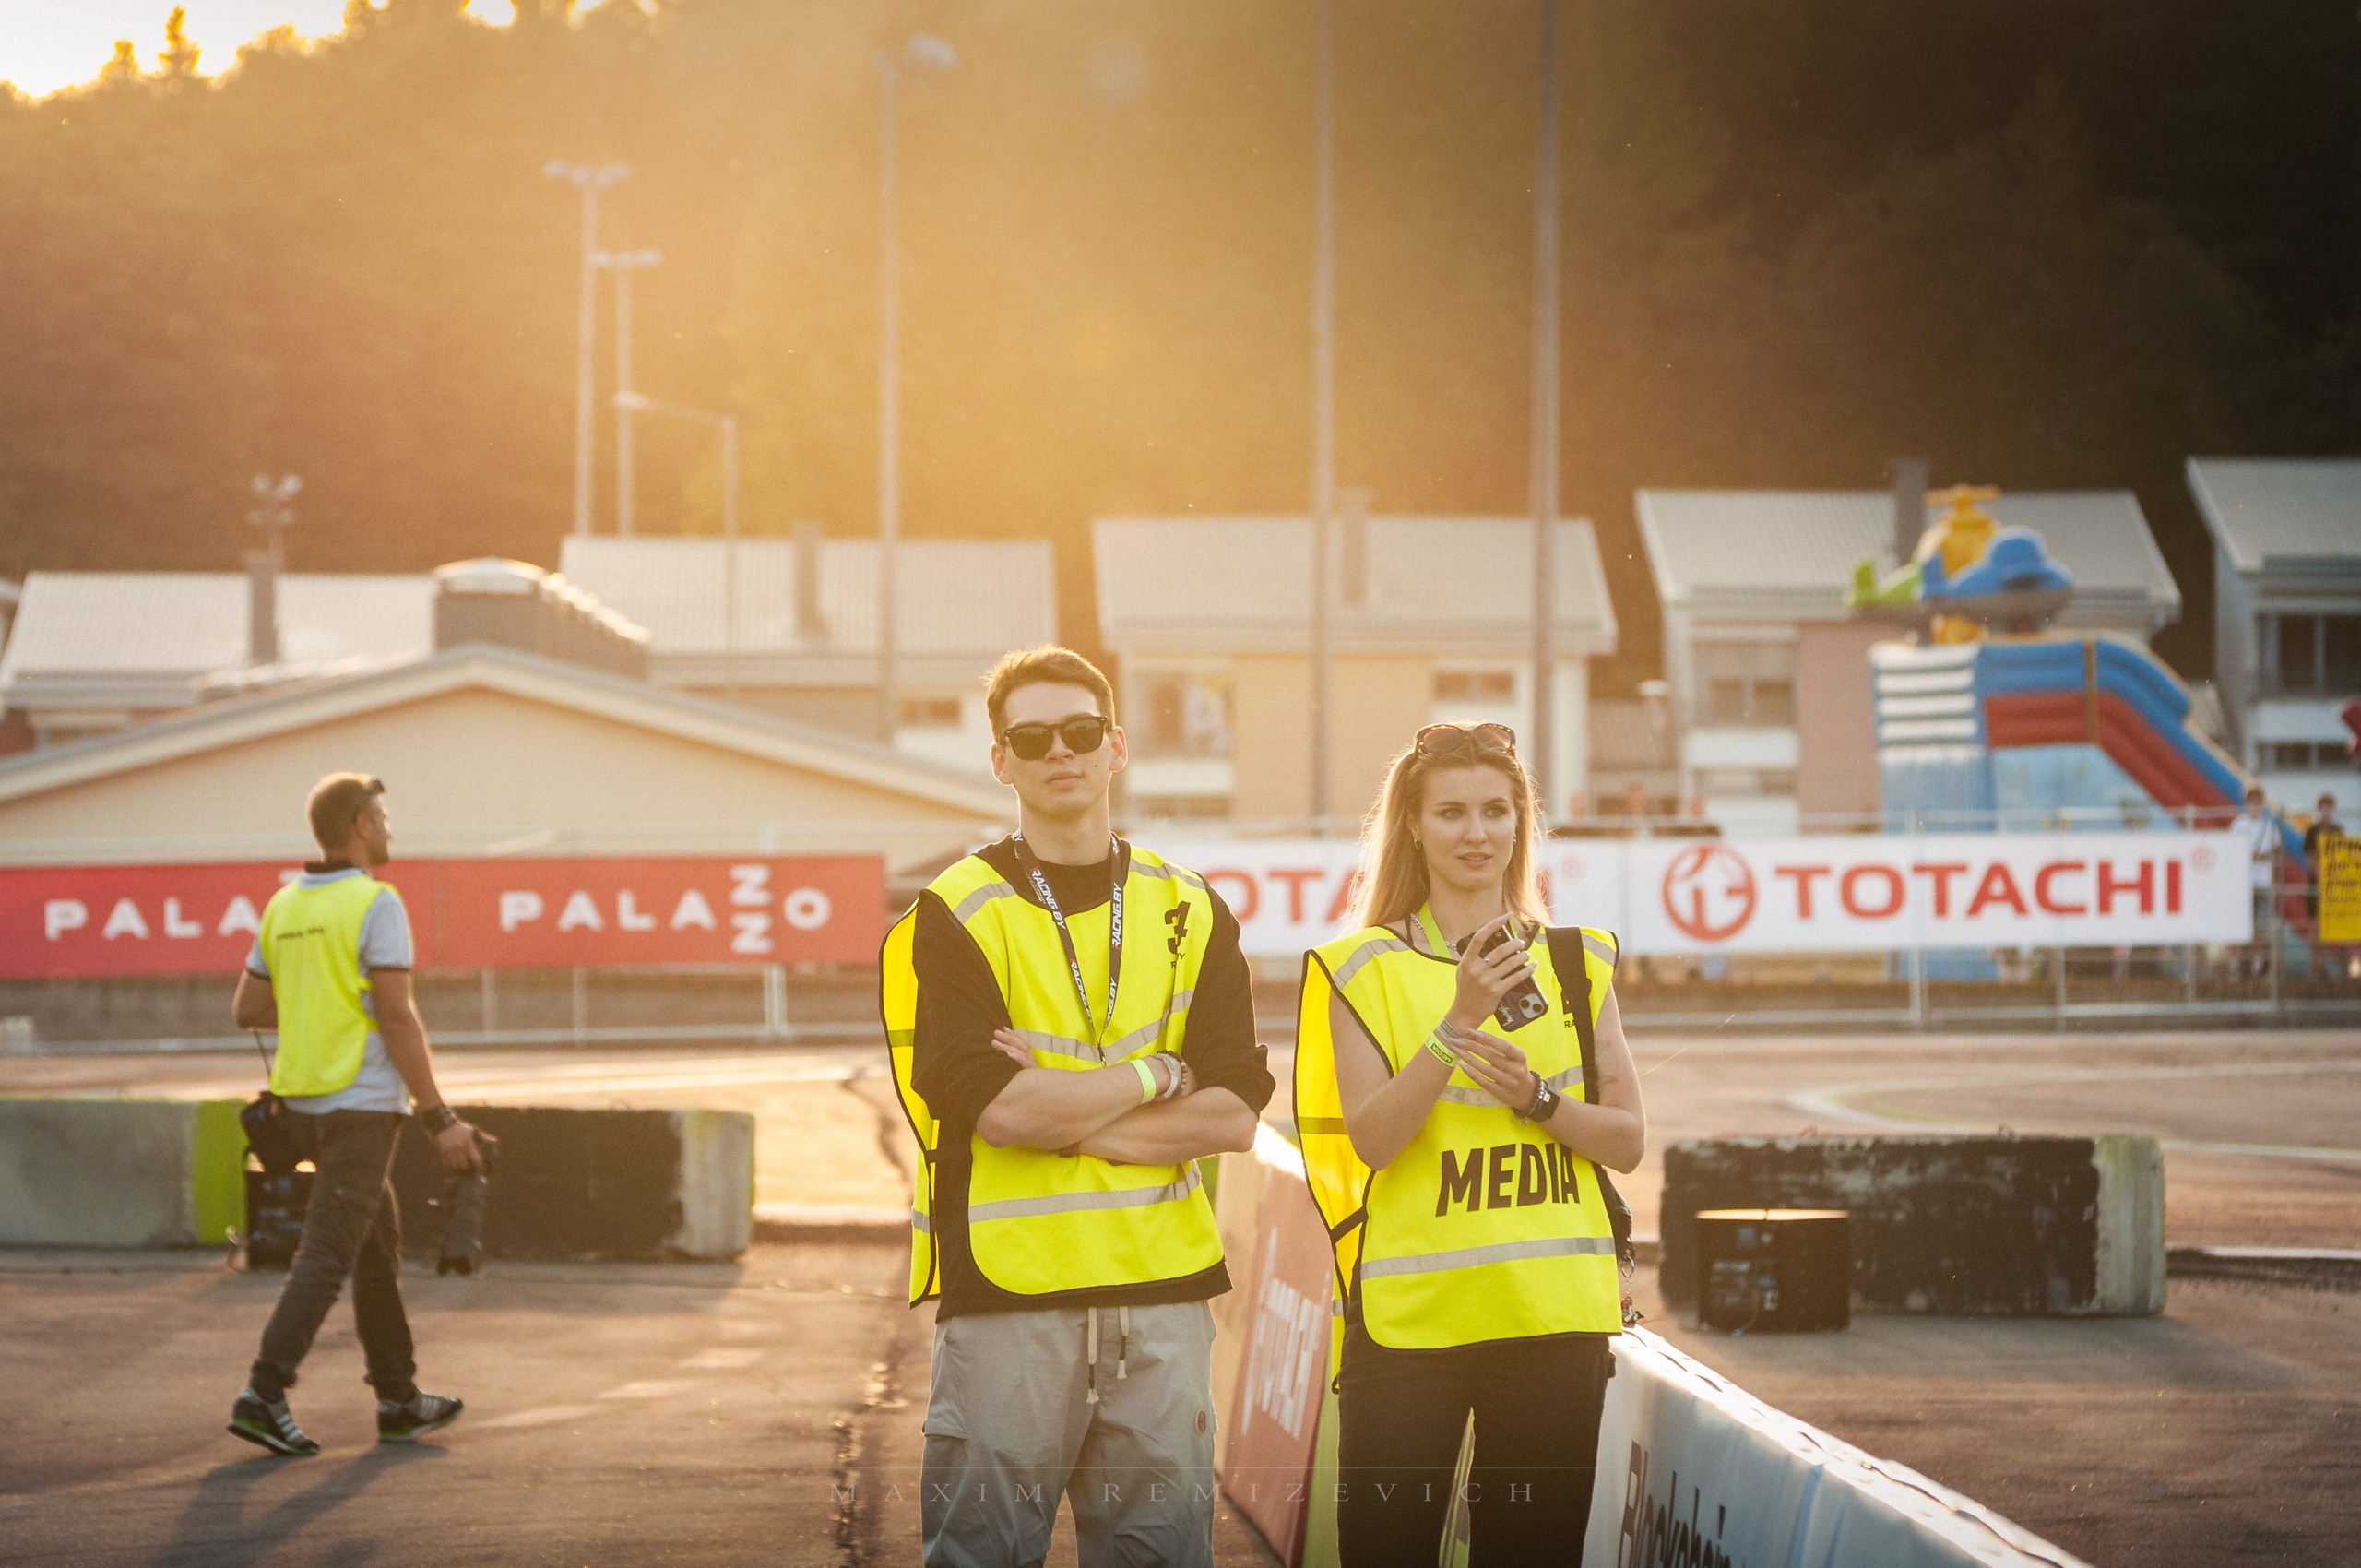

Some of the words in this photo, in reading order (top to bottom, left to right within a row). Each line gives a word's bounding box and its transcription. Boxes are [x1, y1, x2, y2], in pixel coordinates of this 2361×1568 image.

[43, 872, 303, 940] PALA
[499, 864, 832, 954] PALAZZO
[1775, 861, 2184, 921] TOTACHI
[1435, 1143, 1580, 1217] MEDIA
